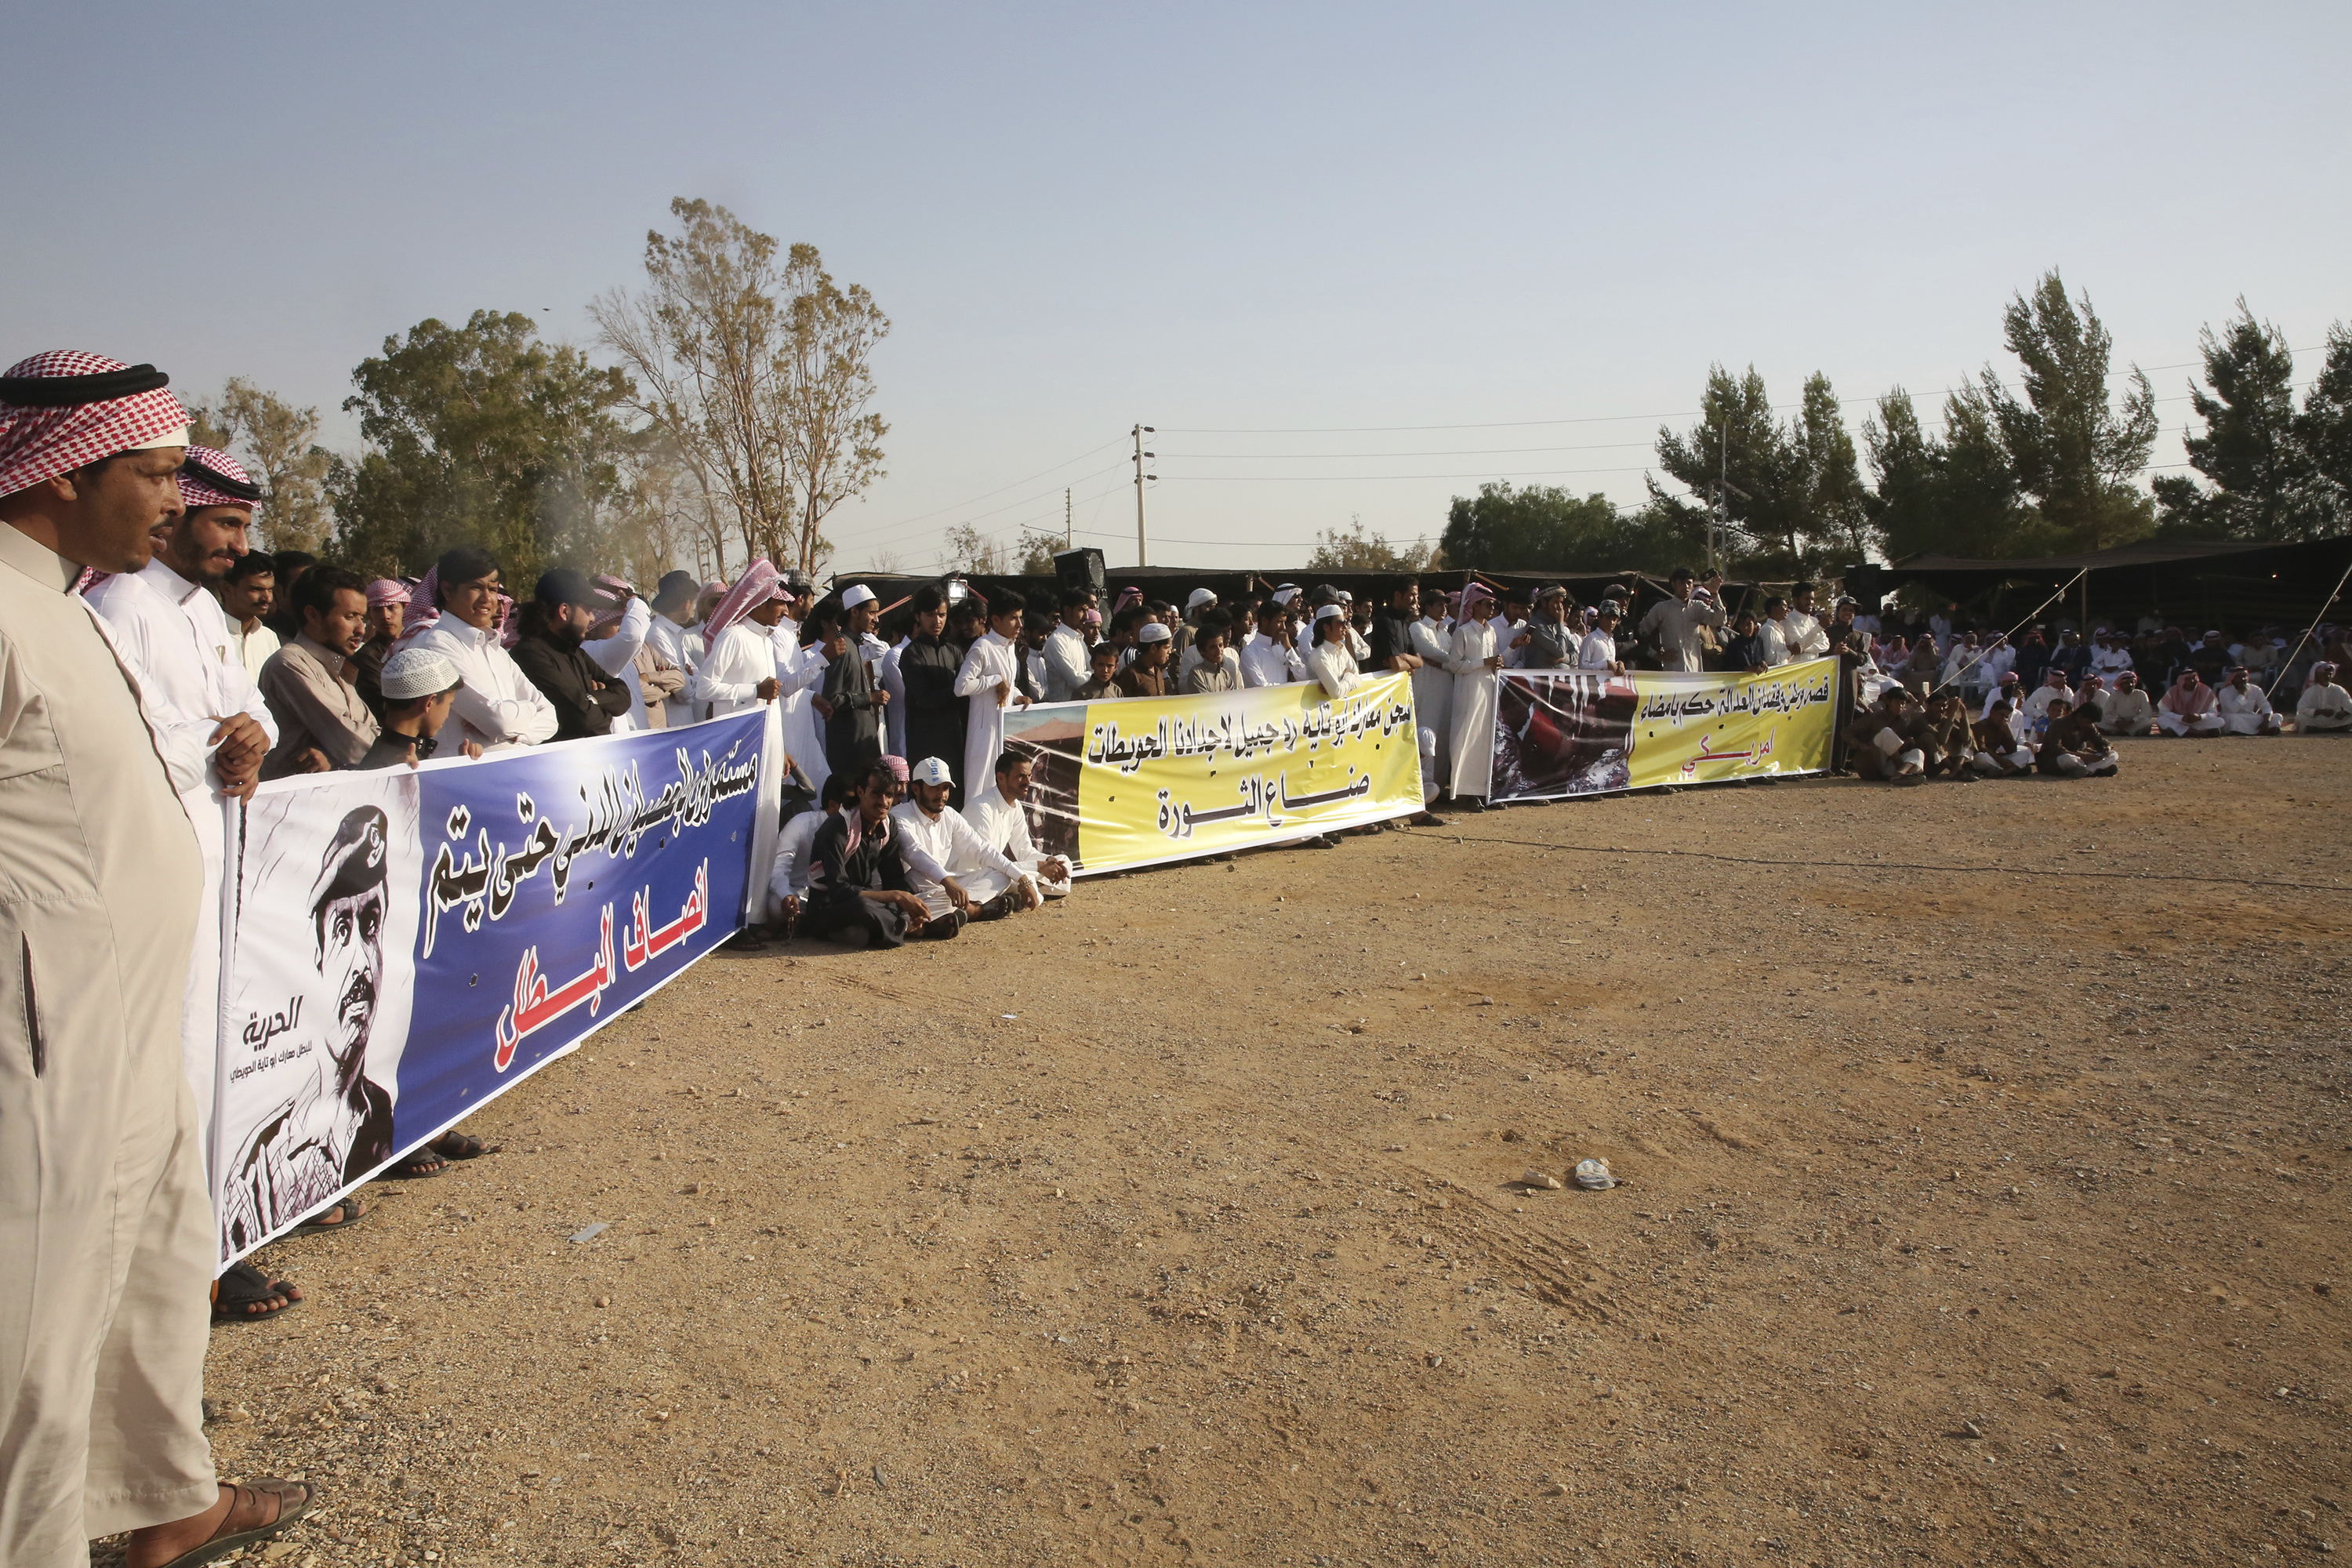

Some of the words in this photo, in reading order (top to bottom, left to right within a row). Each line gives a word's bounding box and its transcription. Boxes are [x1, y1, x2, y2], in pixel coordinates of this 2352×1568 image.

[1349, 694, 1381, 742] معارك
[1383, 694, 1410, 739] سجن
[1639, 691, 1679, 725] بامضاء
[1679, 690, 1715, 729] حكم
[1716, 683, 1755, 717] العدالة
[1751, 681, 1787, 717] وفقدان
[1782, 678, 1805, 713] وطن
[1087, 715, 1170, 776] الحويطات
[1234, 710, 1281, 758] جميل
[1282, 715, 1299, 752] رد
[1680, 726, 1777, 779] امريكي
[1156, 772, 1263, 841] الثورة
[1265, 764, 1371, 828] صناع
[488, 791, 561, 921] حتى
[551, 763, 624, 906] المدني
[423, 804, 492, 959] يتم
[623, 857, 709, 972] انصاف
[494, 902, 616, 1073] البطل
[242, 994, 304, 1052] الحرية
[230, 1059, 257, 1083] الحويطي
[256, 1055, 269, 1073] تاية
[278, 1049, 296, 1064] معارك
[295, 1040, 313, 1058] للبطل
